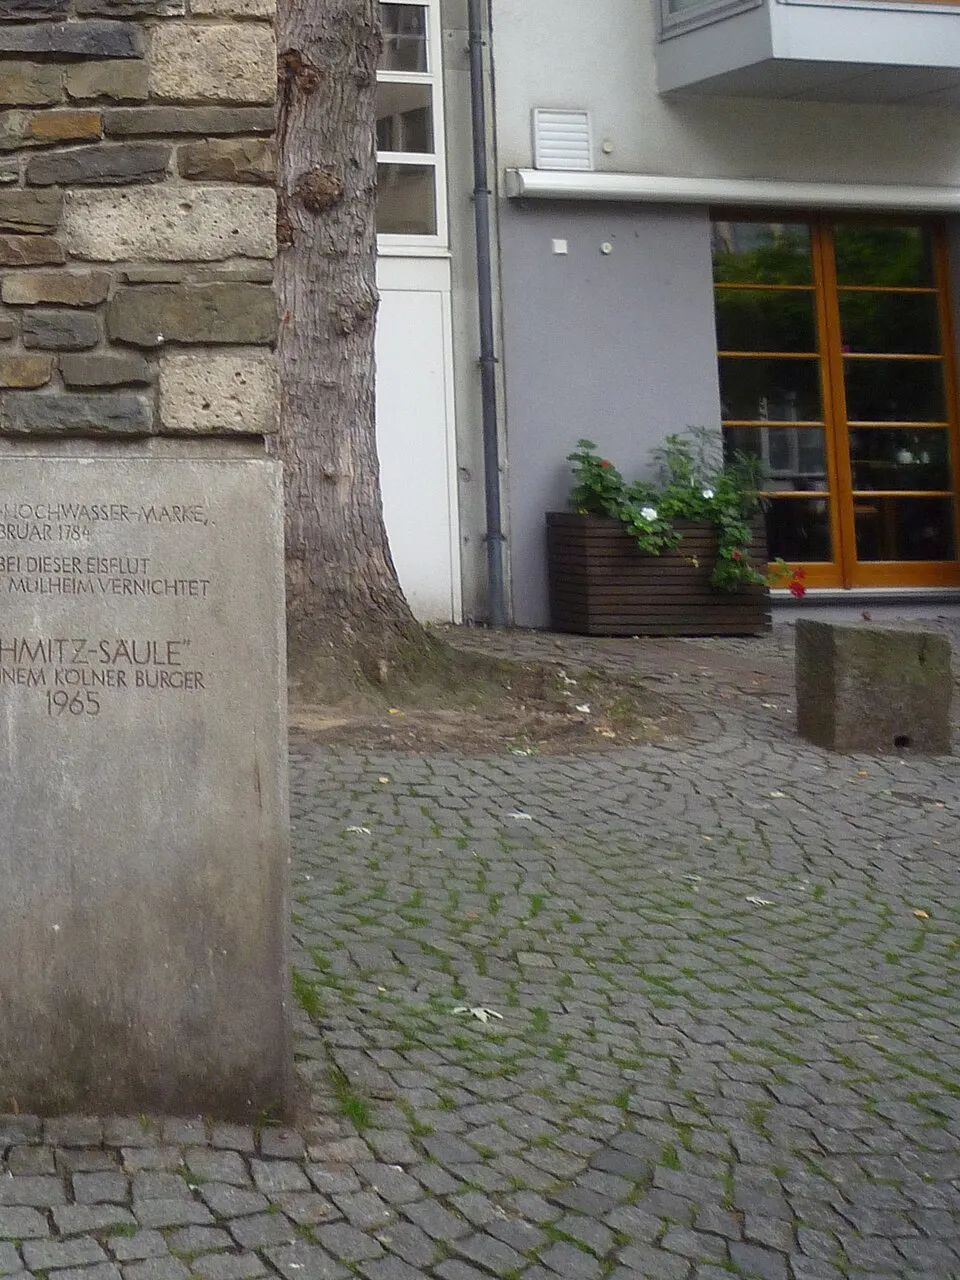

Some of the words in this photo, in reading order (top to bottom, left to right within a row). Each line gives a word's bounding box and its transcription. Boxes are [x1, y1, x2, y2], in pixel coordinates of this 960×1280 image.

[58, 524, 91, 542] 1784
[26, 556, 82, 574] DIESER
[87, 557, 150, 575] EISFLUT
[98, 578, 210, 597] VERNICHTET
[46, 690, 100, 717] 1965
